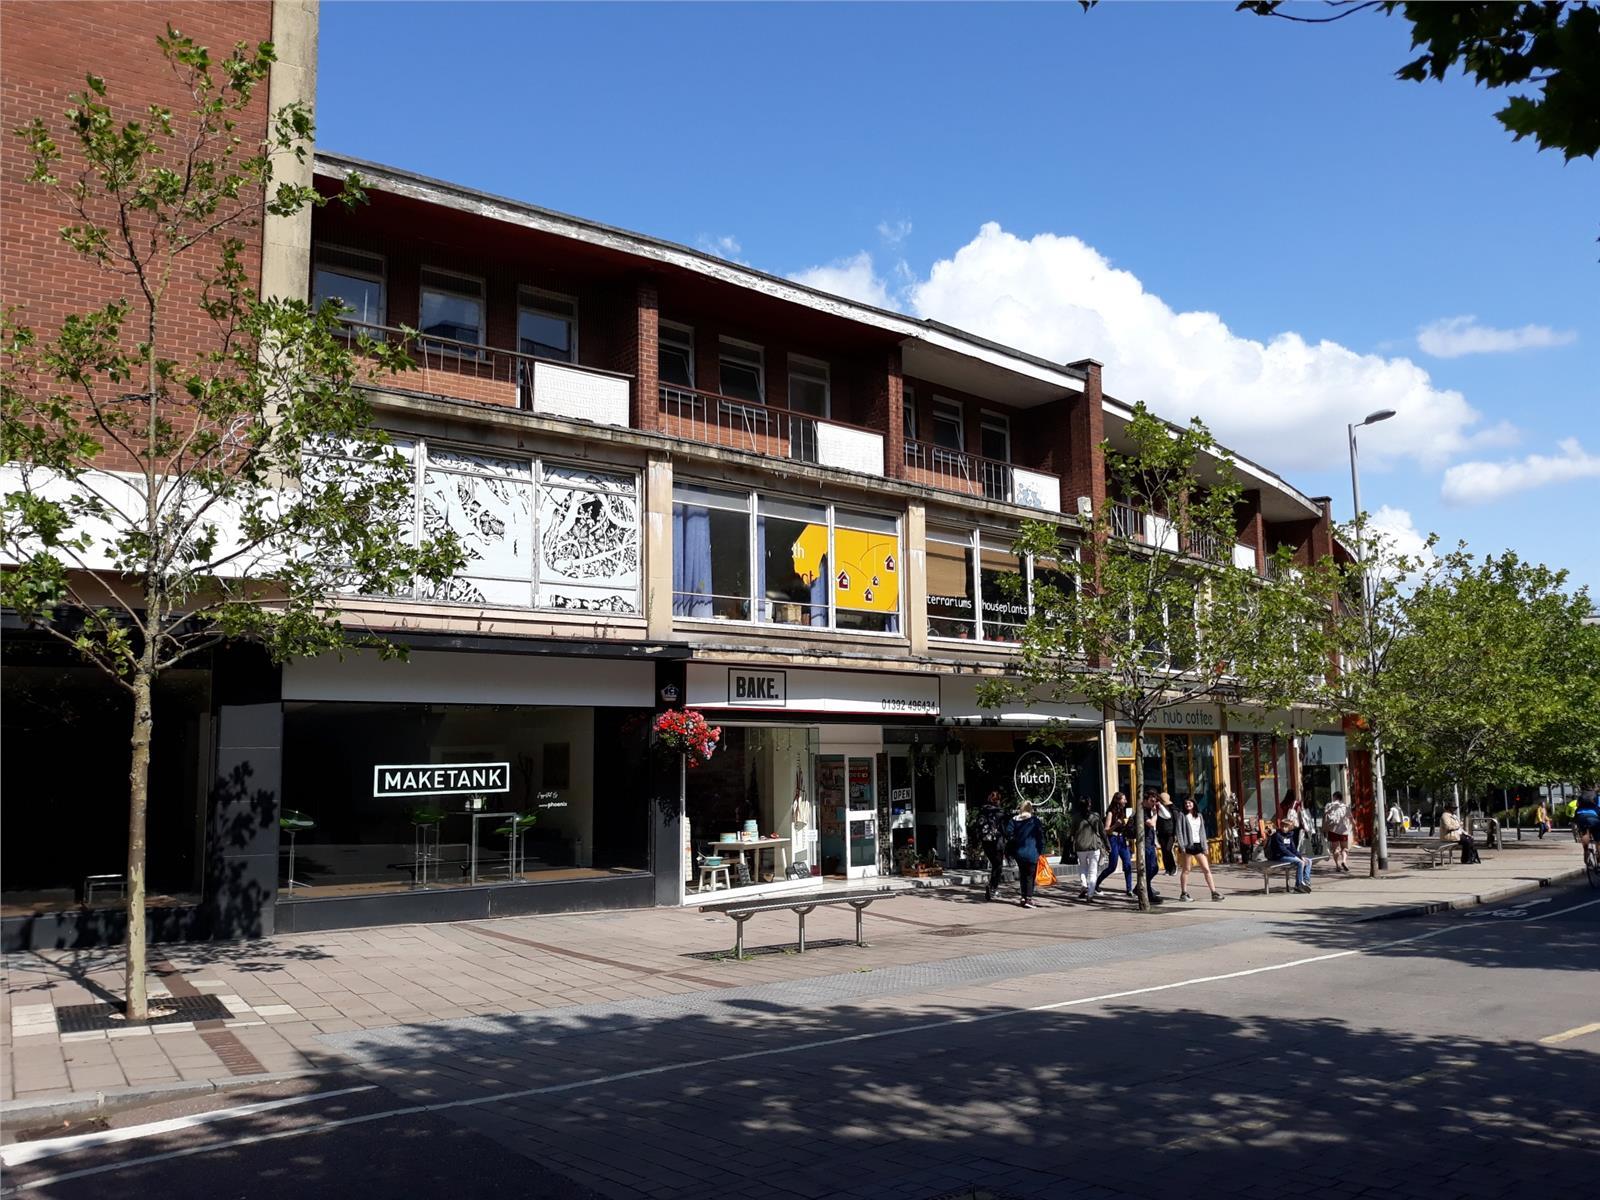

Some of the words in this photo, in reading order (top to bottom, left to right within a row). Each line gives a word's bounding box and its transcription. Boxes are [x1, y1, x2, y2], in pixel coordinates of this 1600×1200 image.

[927, 594, 972, 609] terrariums
[981, 600, 1028, 615] houseplants
[736, 676, 779, 699] BAKE.
[881, 698, 906, 711] 01392
[908, 700, 936, 712] 496434
[1162, 708, 1183, 725] hub
[1185, 708, 1214, 725] coffee
[384, 768, 502, 790] MAKETANK
[1020, 771, 1051, 784] hutch
[893, 789, 911, 800] OPEN
